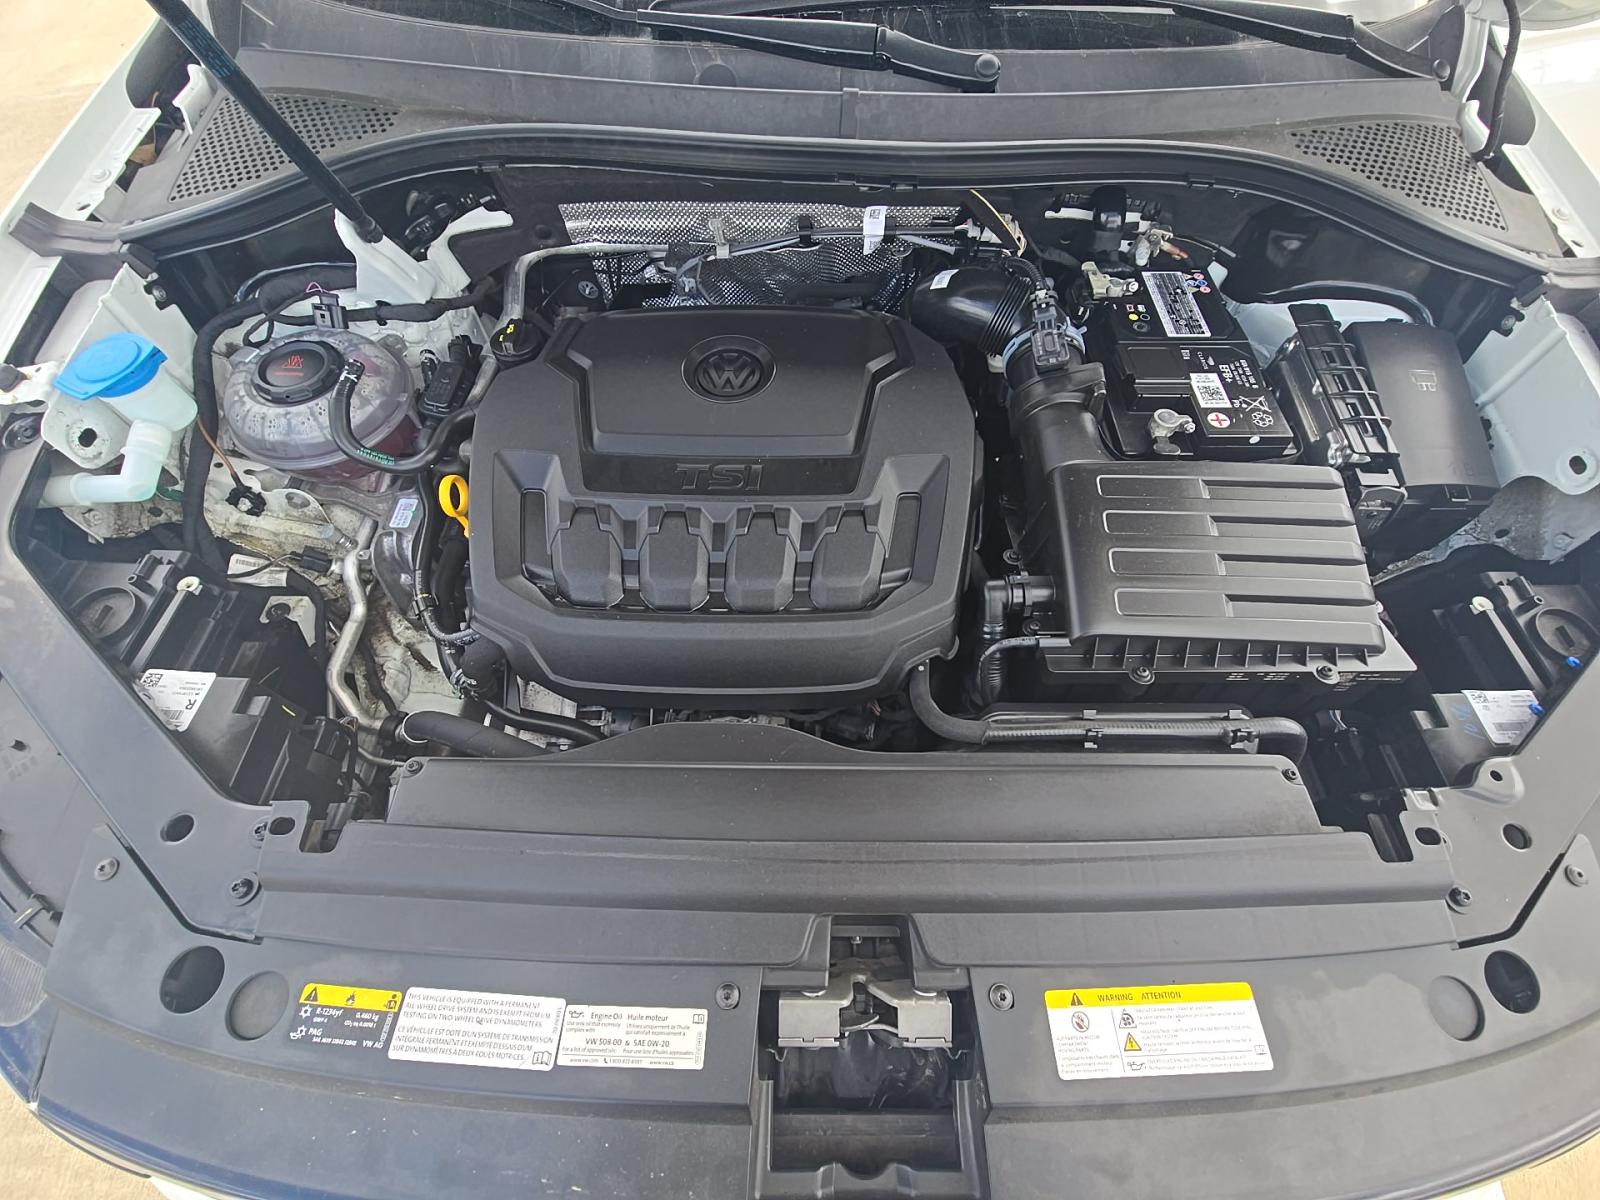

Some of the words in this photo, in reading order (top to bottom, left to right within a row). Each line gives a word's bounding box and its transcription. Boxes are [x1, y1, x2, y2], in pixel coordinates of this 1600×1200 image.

[1219, 364, 1233, 383] EFB+
[675, 463, 764, 490] TSI
[185, 699, 197, 710] R
[421, 993, 446, 1002] VEHICLE
[1097, 992, 1133, 1003] WARNING
[1141, 991, 1182, 1000] ATTENTION
[315, 1008, 344, 1018] R-1234yf
[402, 1010, 428, 1018] TESTING
[590, 1012, 612, 1021] Engine
[627, 1012, 644, 1020] Huile
[308, 1028, 323, 1036] PAG
[362, 1040, 373, 1048] VW
[373, 1041, 384, 1049] AG
[646, 1039, 670, 1047] 0W-20
